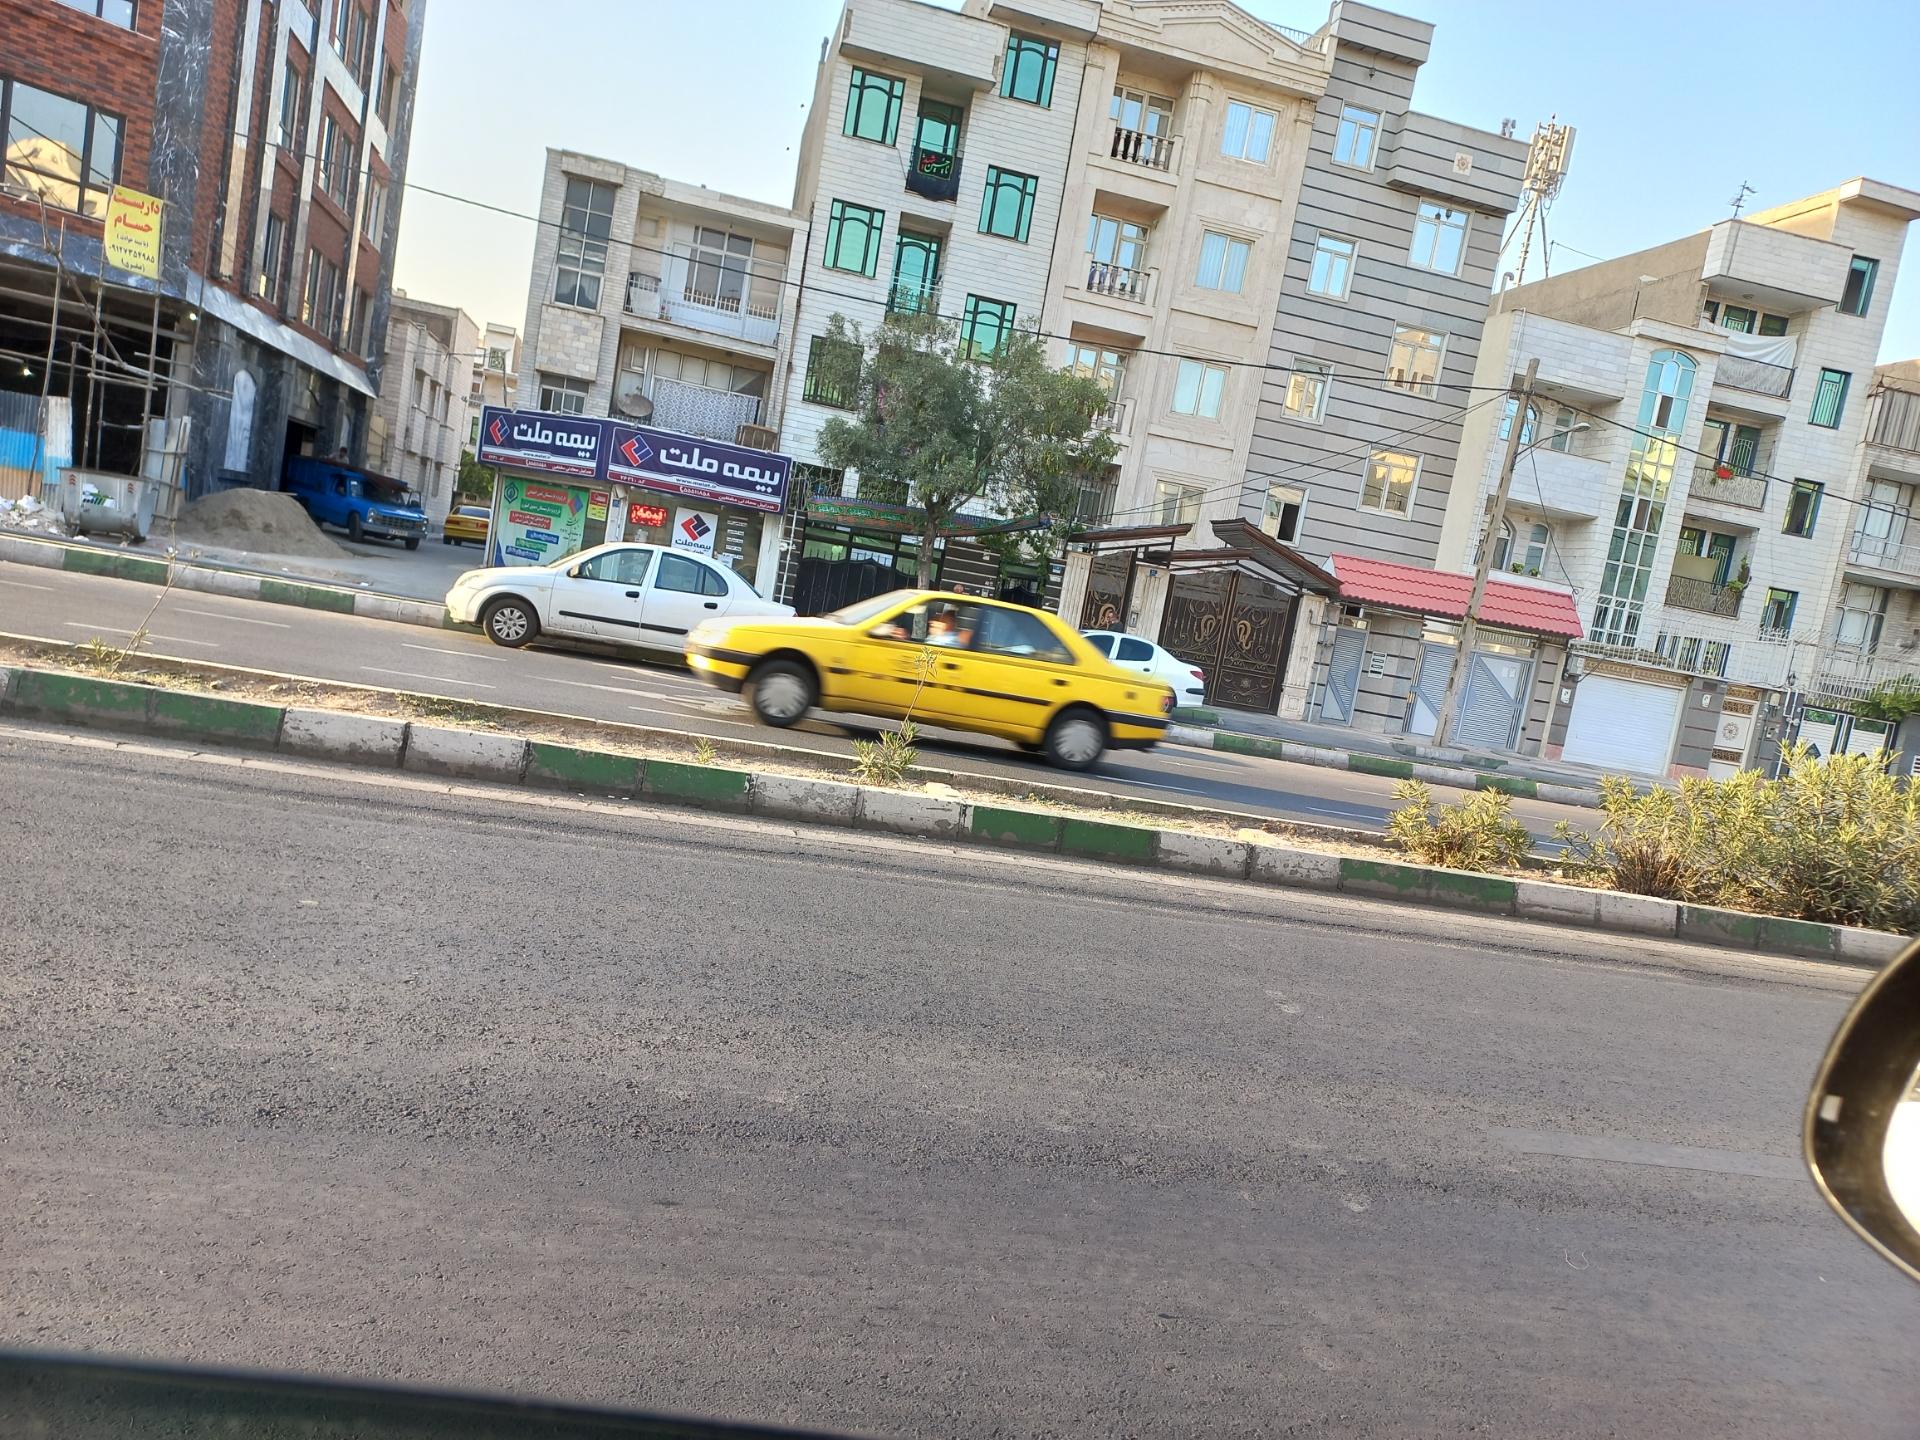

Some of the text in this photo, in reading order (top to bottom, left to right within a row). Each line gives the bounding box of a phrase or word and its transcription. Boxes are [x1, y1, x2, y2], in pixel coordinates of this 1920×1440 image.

[113, 192, 160, 215] داربست
[114, 213, 153, 233] حسام
[513, 421, 597, 458] بیمه ملت
[659, 447, 781, 494] بیمه ملت
[675, 538, 712, 551] بیمه ملت
